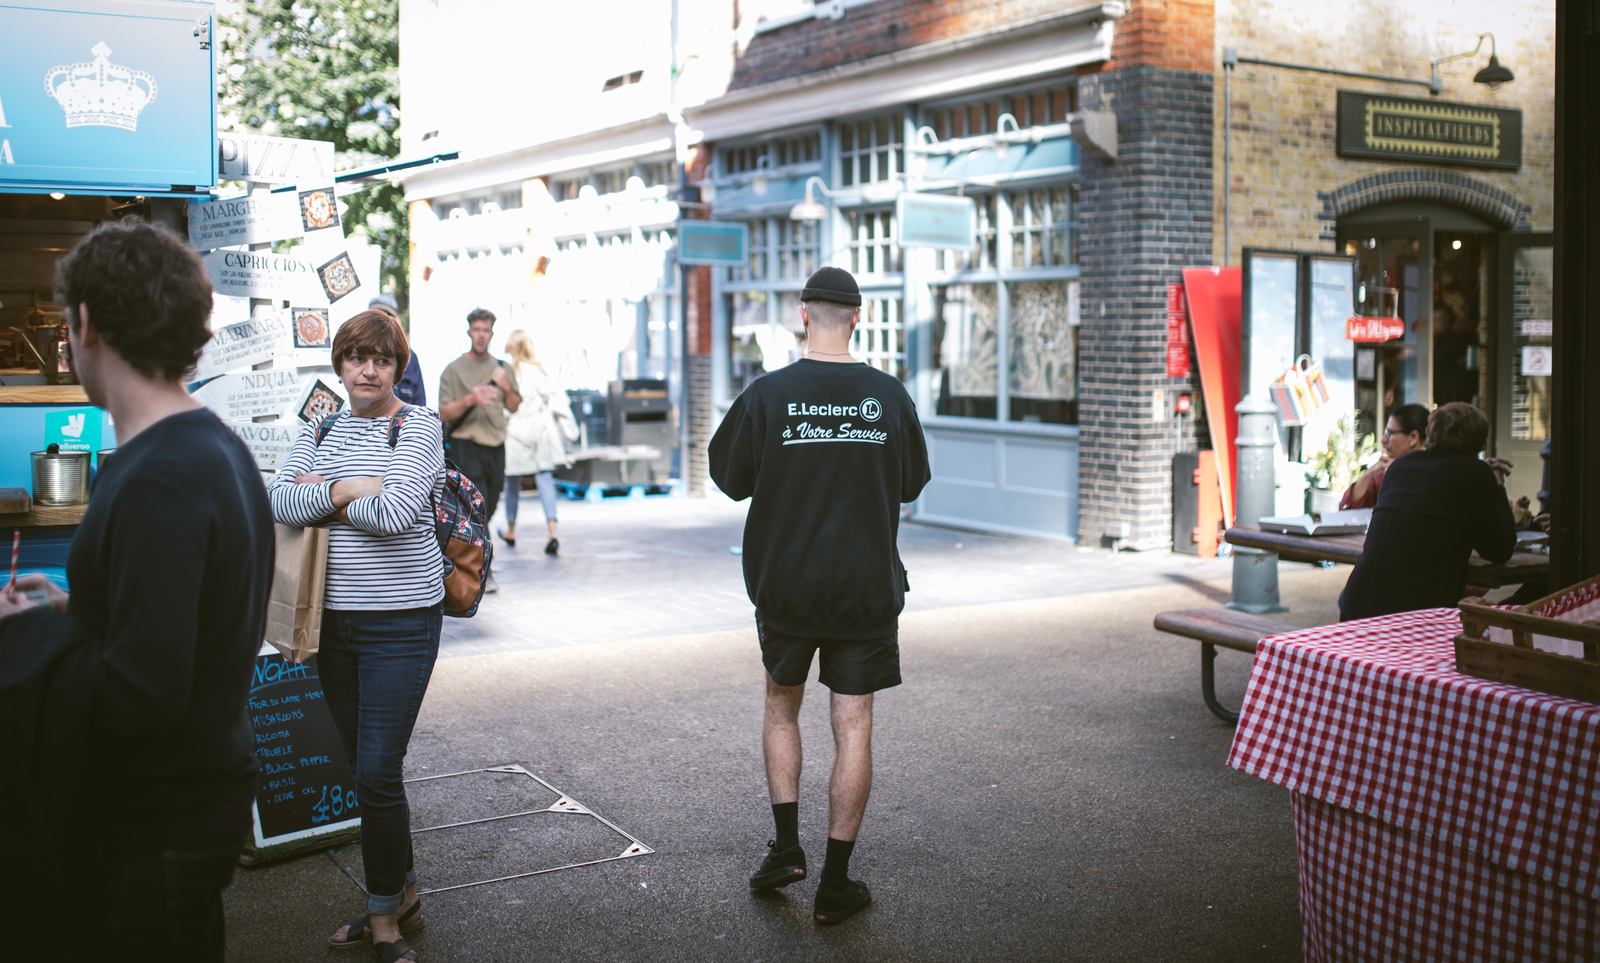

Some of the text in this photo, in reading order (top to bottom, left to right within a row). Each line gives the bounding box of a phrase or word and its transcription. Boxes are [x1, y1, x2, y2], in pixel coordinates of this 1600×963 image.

[218, 138, 326, 178] PIZZA
[211, 317, 285, 346] MARINARA
[787, 402, 858, 417] E.Leclerc
[782, 422, 888, 441] à Votre Service
[251, 656, 312, 688] NOAH
[257, 744, 293, 758] TRUFFLE
[265, 762, 297, 775] BLACK
[268, 776, 298, 790] BASIL
